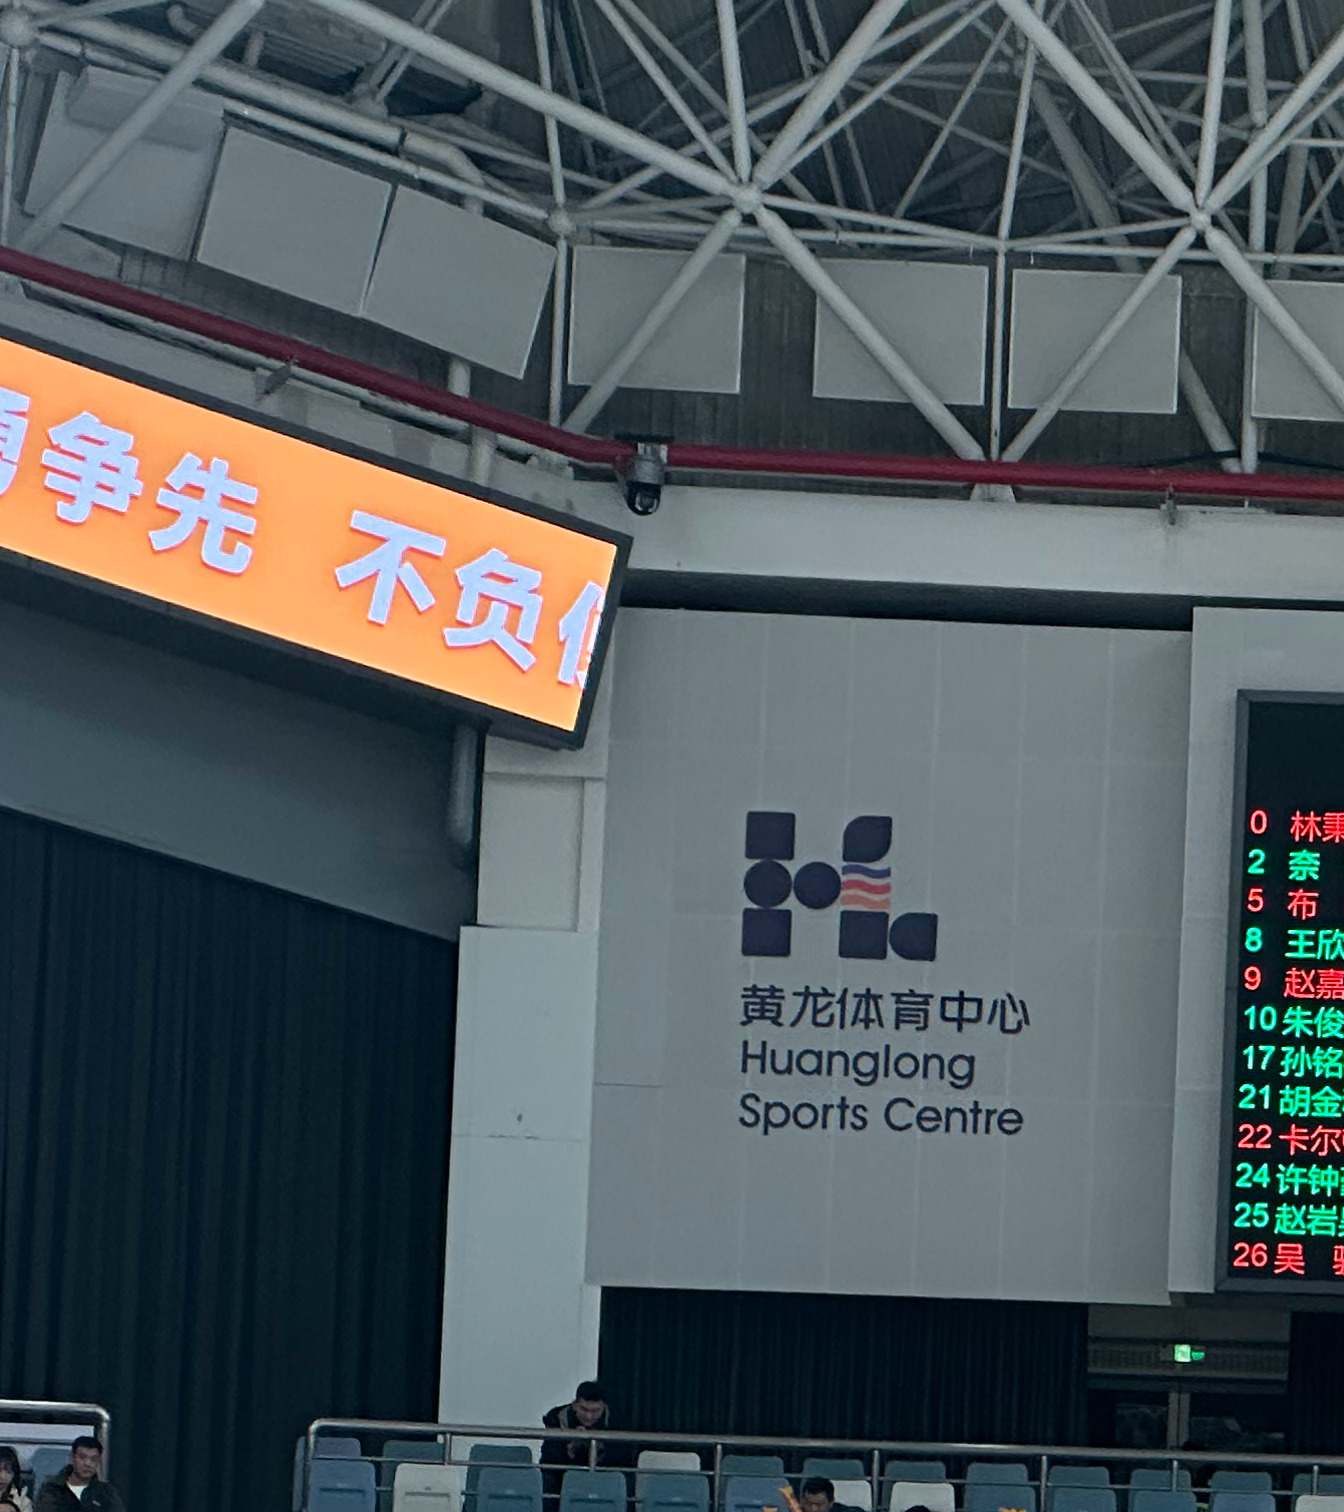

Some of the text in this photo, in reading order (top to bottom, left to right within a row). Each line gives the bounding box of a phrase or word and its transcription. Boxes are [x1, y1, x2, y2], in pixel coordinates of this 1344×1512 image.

[1250, 810, 1267, 834] 0
[1248, 849, 1265, 874] 2
[1248, 888, 1264, 912] 5
[1245, 927, 1262, 952] 8
[1244, 966, 1261, 990] 9
[740, 984, 1030, 1035] 黄龙体育中心
[1245, 1006, 1276, 1030] 10
[741, 1040, 976, 1090] Huanglong
[1243, 1046, 1275, 1070] 17
[1239, 1084, 1270, 1109] 21
[739, 1093, 1024, 1136] Sports Centre
[1238, 1124, 1272, 1148] 22
[1236, 1163, 1270, 1187] 24
[1234, 1202, 1269, 1227] 25
[1234, 1242, 1267, 1266] 26
